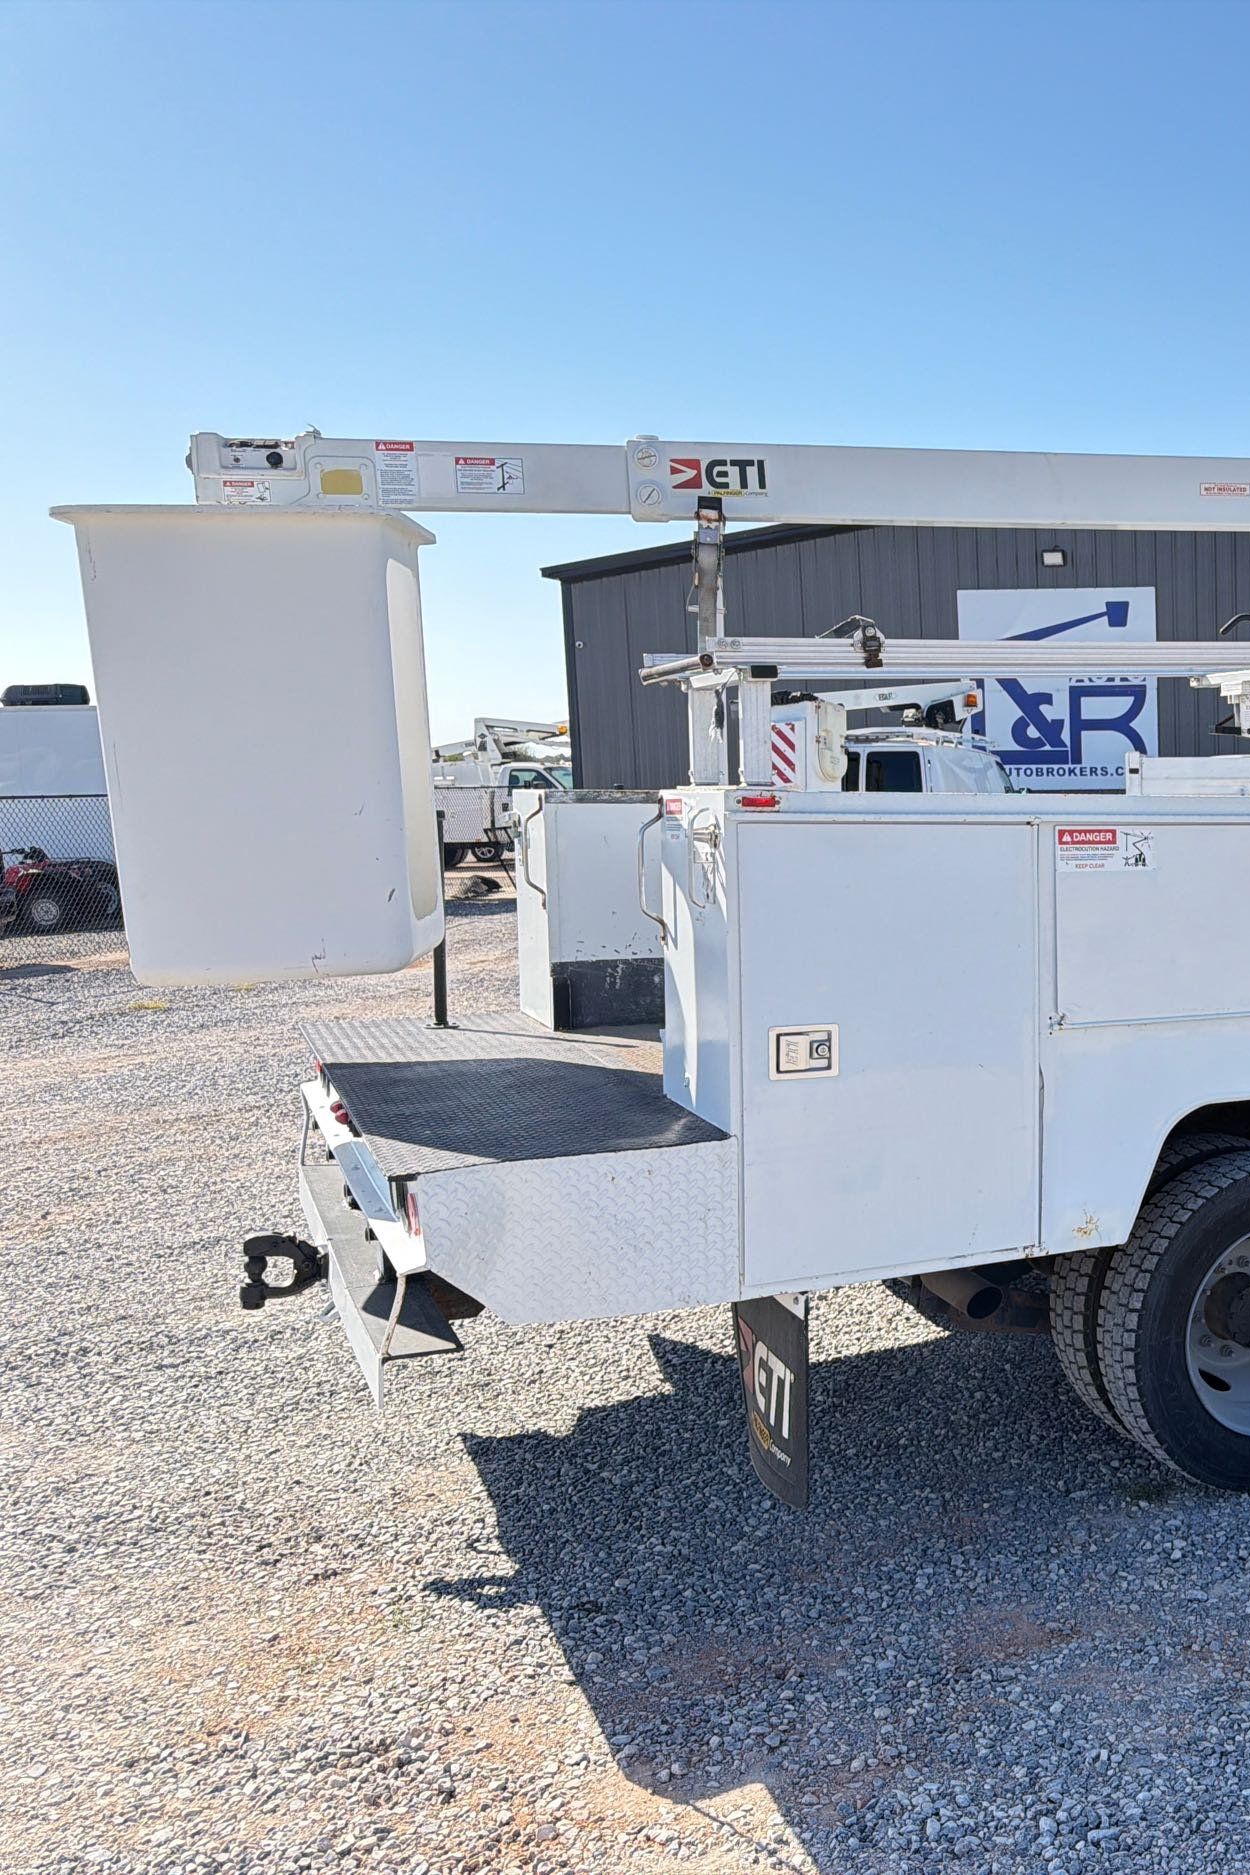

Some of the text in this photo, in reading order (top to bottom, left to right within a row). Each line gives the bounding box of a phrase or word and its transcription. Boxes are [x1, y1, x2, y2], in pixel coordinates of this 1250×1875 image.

[705, 459, 766, 489] ETI
[1073, 832, 1113, 841] DANGER
[754, 1340, 792, 1440] ETI
[770, 1439, 792, 1468] Company
